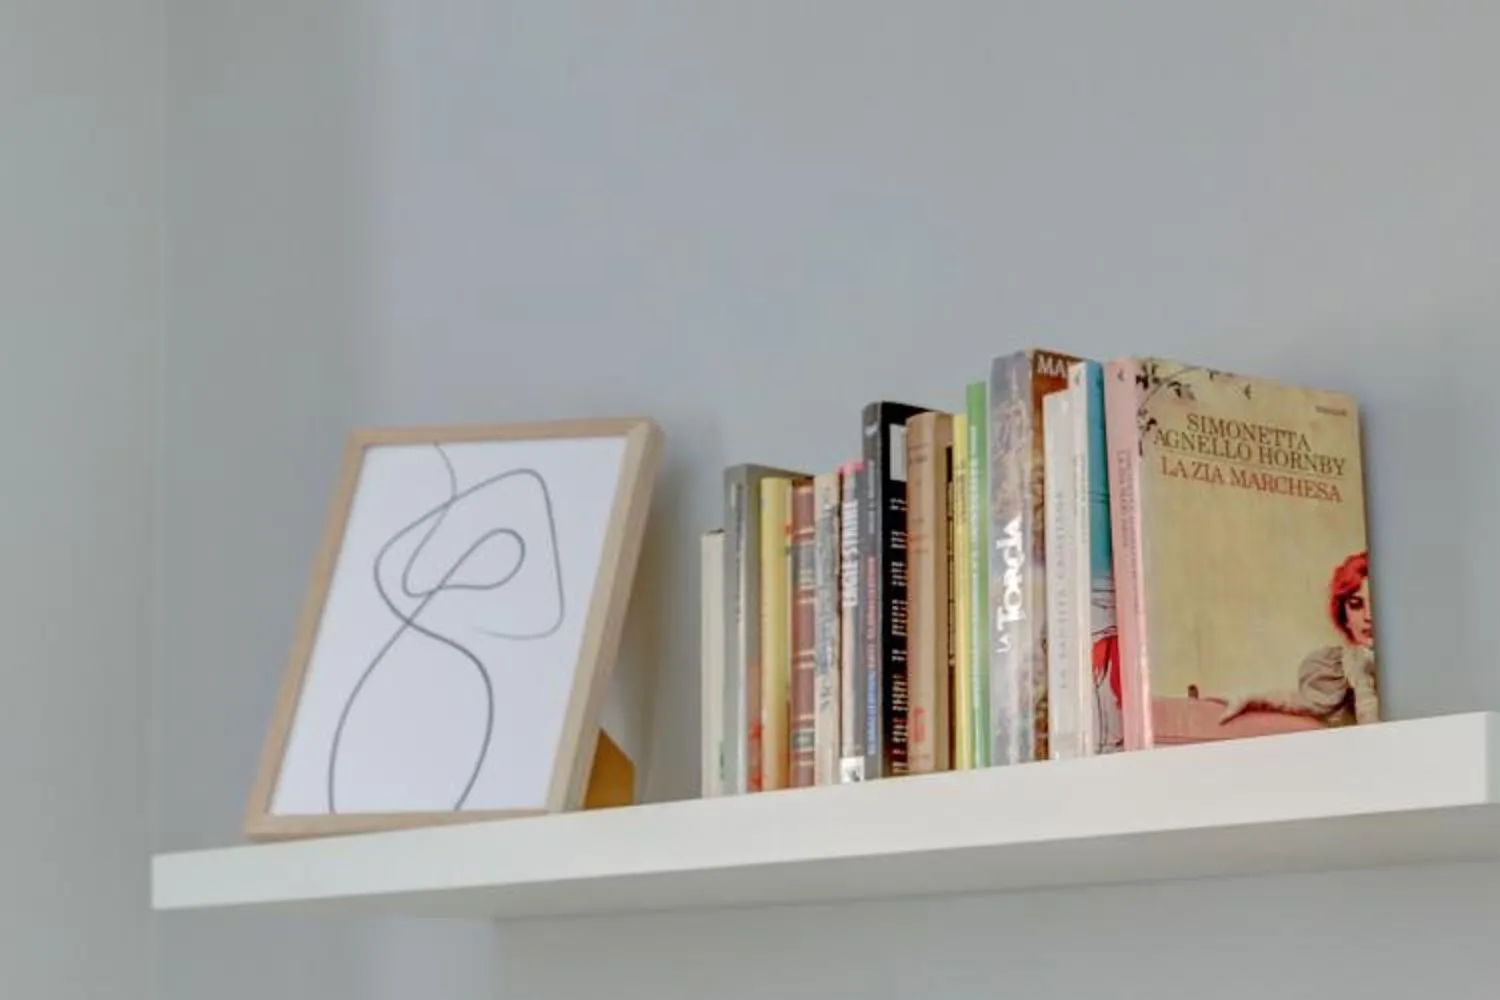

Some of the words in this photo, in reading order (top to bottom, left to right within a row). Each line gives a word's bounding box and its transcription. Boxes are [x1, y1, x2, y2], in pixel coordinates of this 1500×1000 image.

[1152, 429, 1251, 464] AGNELLO
[1259, 444, 1347, 477] HORNBY
[1186, 414, 1310, 452] SIMONETTA
[1161, 456, 1189, 479] LA
[1189, 460, 1223, 484] ZIA
[1232, 471, 1341, 502] MARCHESA
[842, 500, 859, 559] STRIKE
[994, 633, 1012, 653] LA
